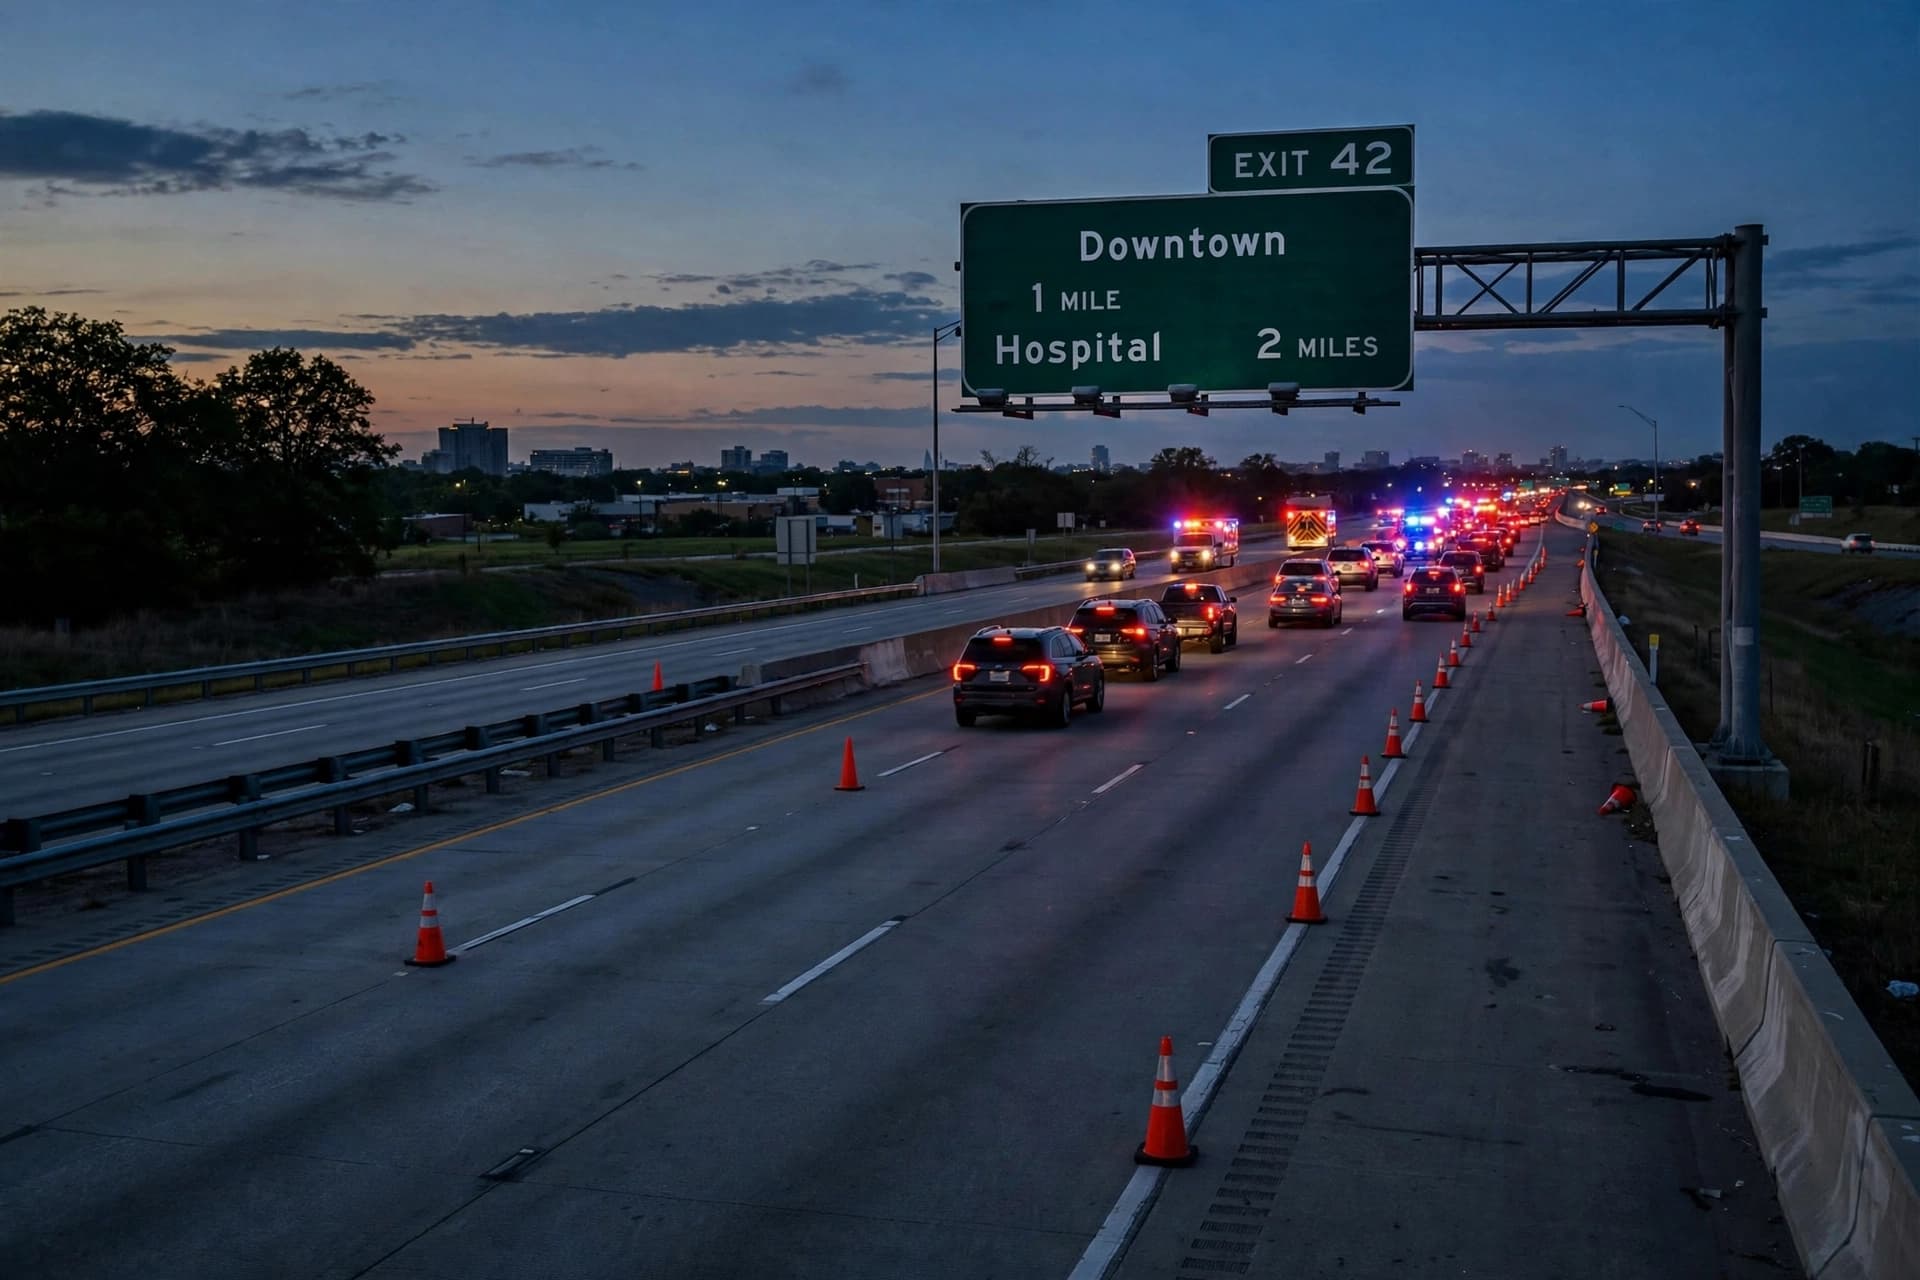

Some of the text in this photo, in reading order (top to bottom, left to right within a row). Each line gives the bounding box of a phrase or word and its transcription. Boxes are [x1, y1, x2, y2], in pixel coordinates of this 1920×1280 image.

[1234, 141, 1393, 178] EXIT 42
[1080, 227, 1286, 262] Downtown
[1031, 282, 1121, 312] 1 MILE
[996, 328, 1379, 370] Hospital 2 MILES
